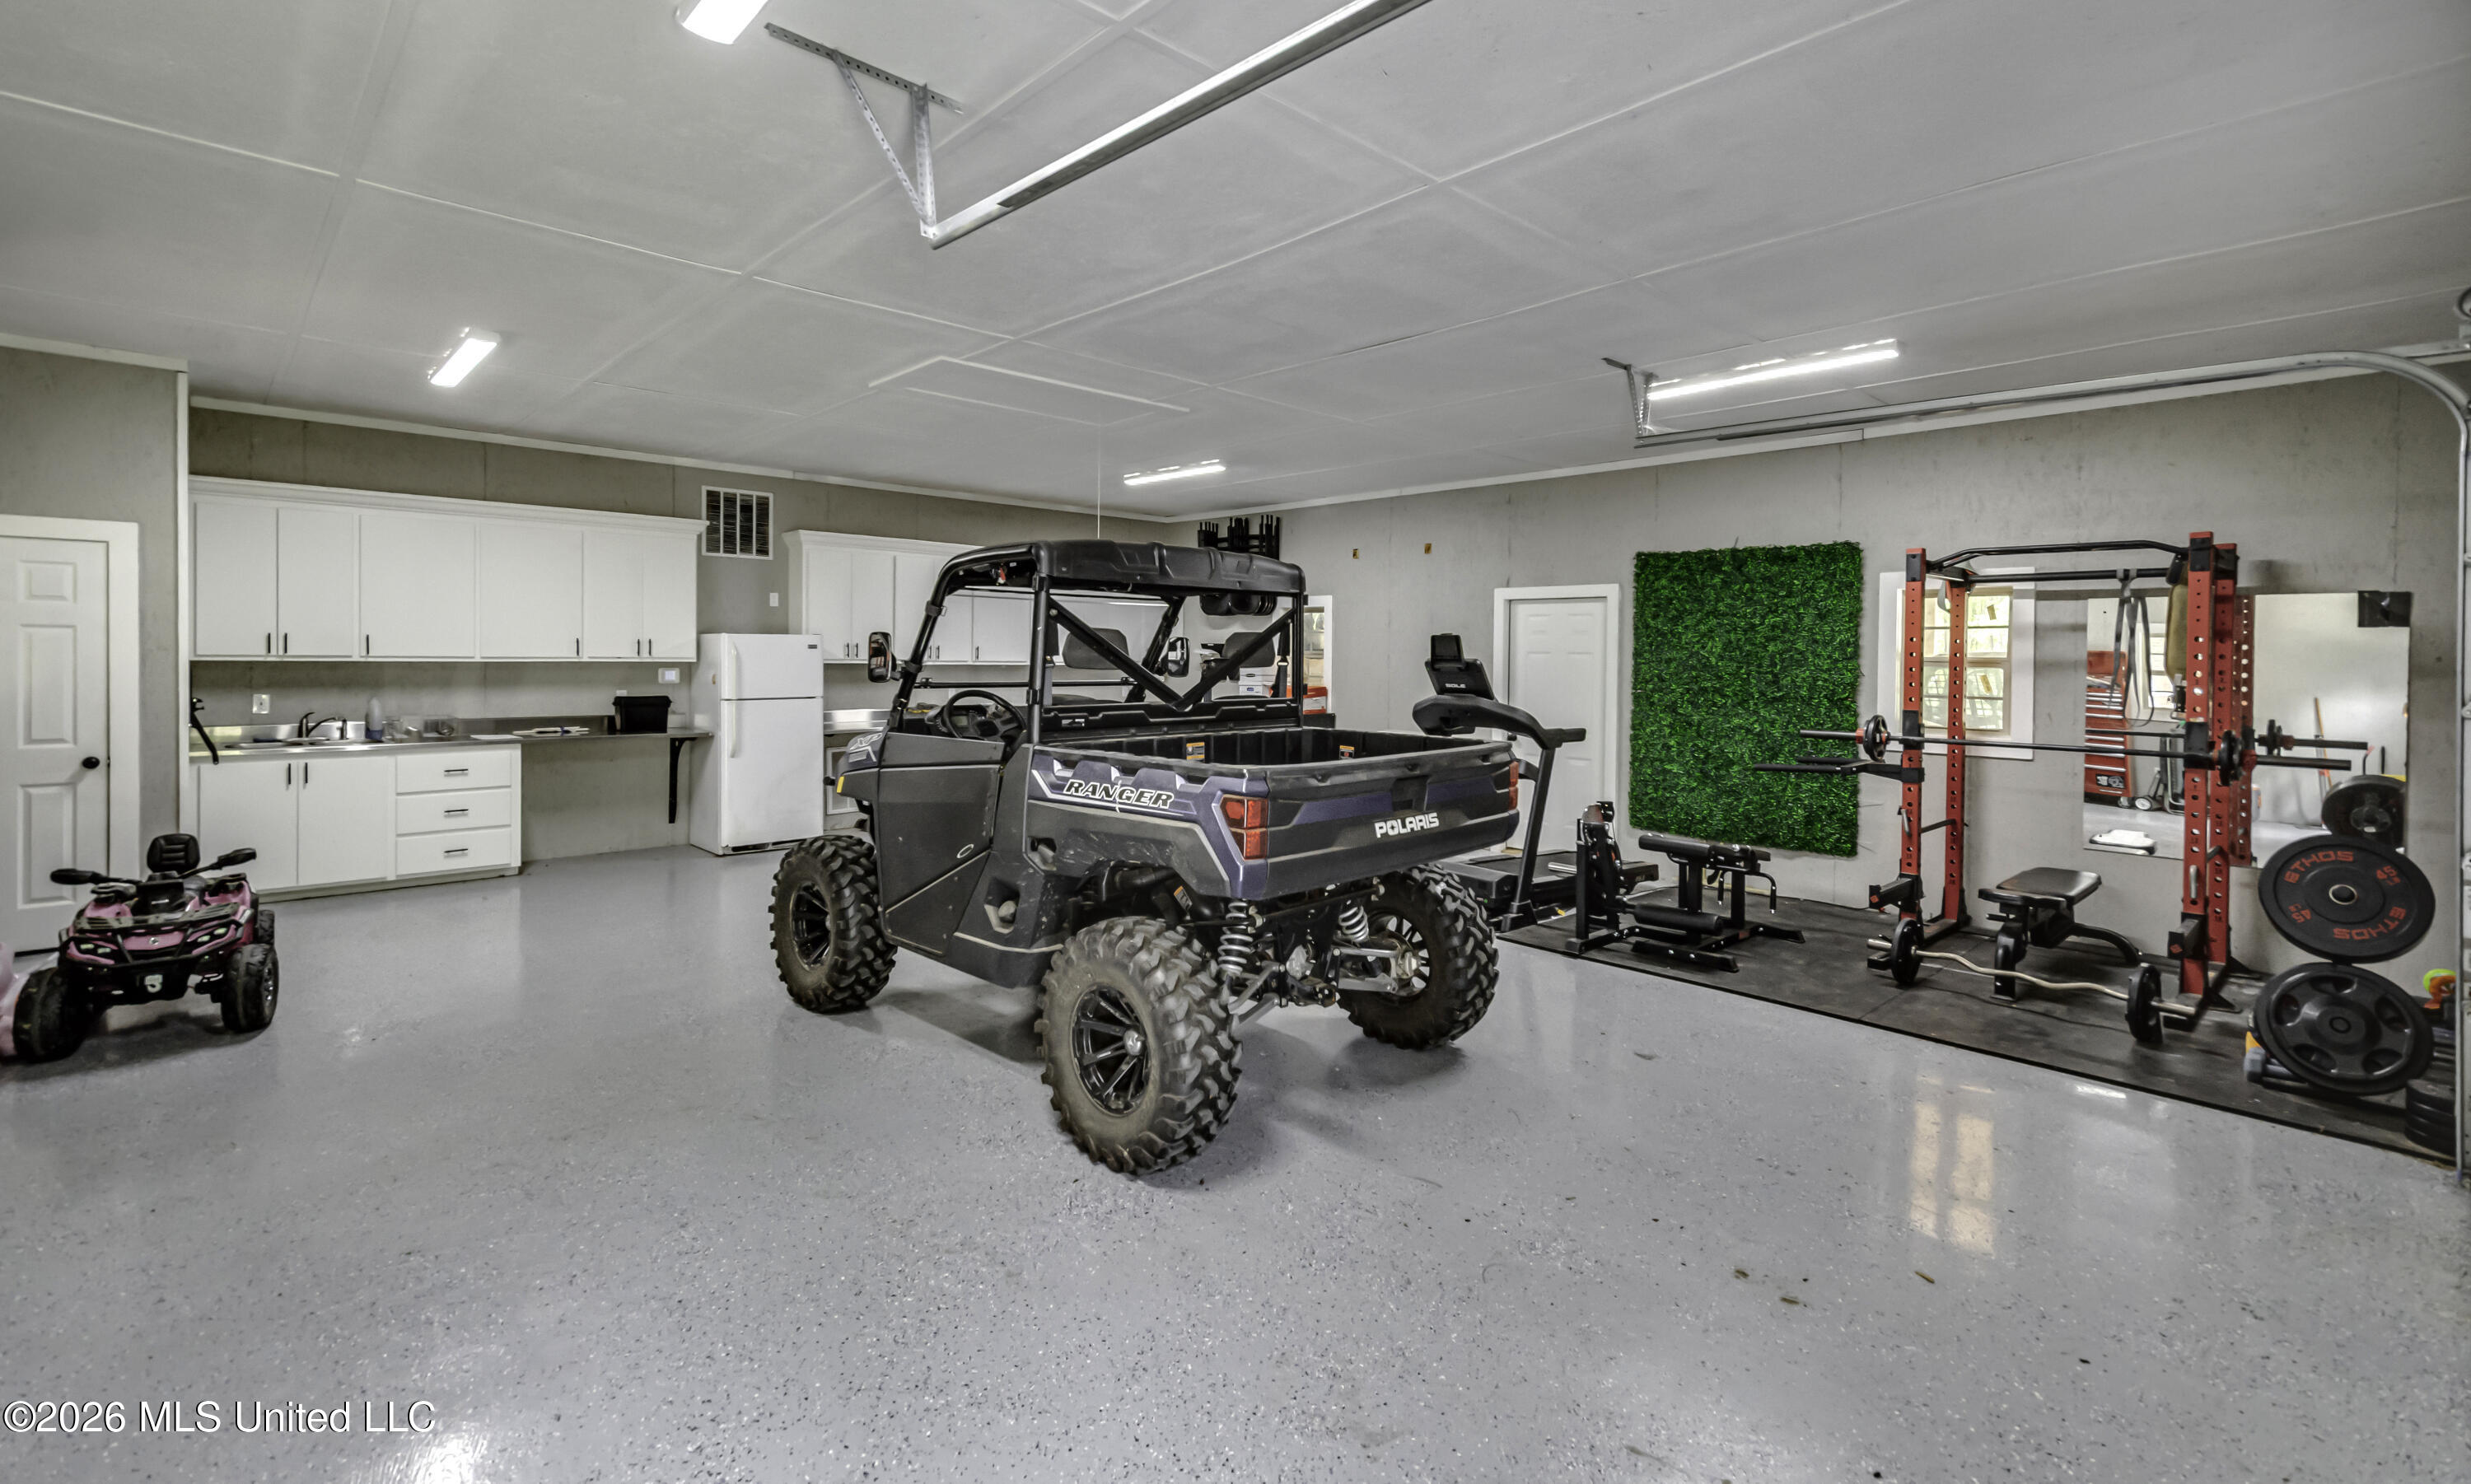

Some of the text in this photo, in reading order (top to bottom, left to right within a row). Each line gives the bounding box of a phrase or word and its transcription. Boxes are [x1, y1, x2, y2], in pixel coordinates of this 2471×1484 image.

[1063, 778, 1175, 810] RANGER
[1374, 812, 1440, 838] POLARIS
[2283, 850, 2355, 884] ETHOS
[2333, 905, 2407, 940] ETHOS
